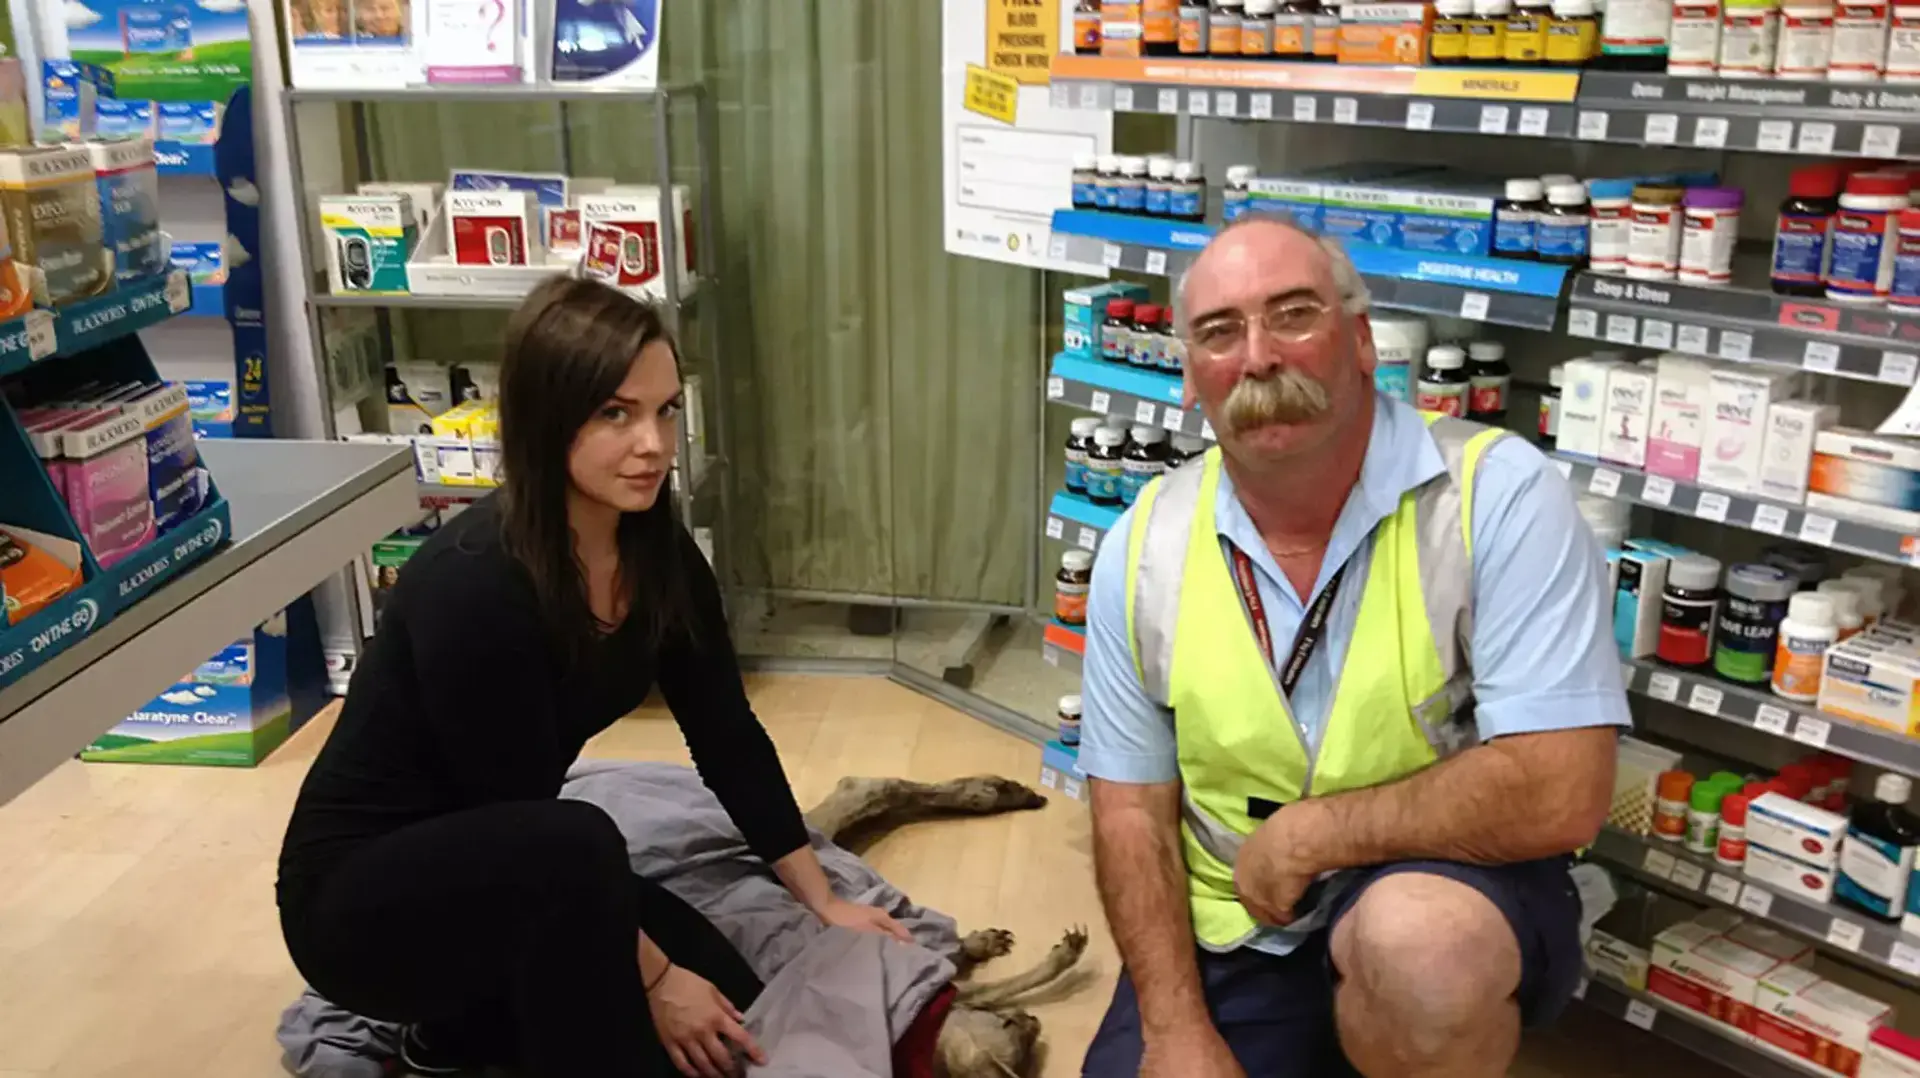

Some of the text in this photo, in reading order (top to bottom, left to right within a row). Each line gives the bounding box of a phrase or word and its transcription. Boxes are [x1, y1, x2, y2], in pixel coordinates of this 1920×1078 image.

[1462, 79, 1520, 93] MINERALS
[1728, 84, 1806, 104] Management
[1864, 91, 1876, 107] &
[1476, 267, 1520, 284] HEALTH
[126, 710, 190, 727] laratyne
